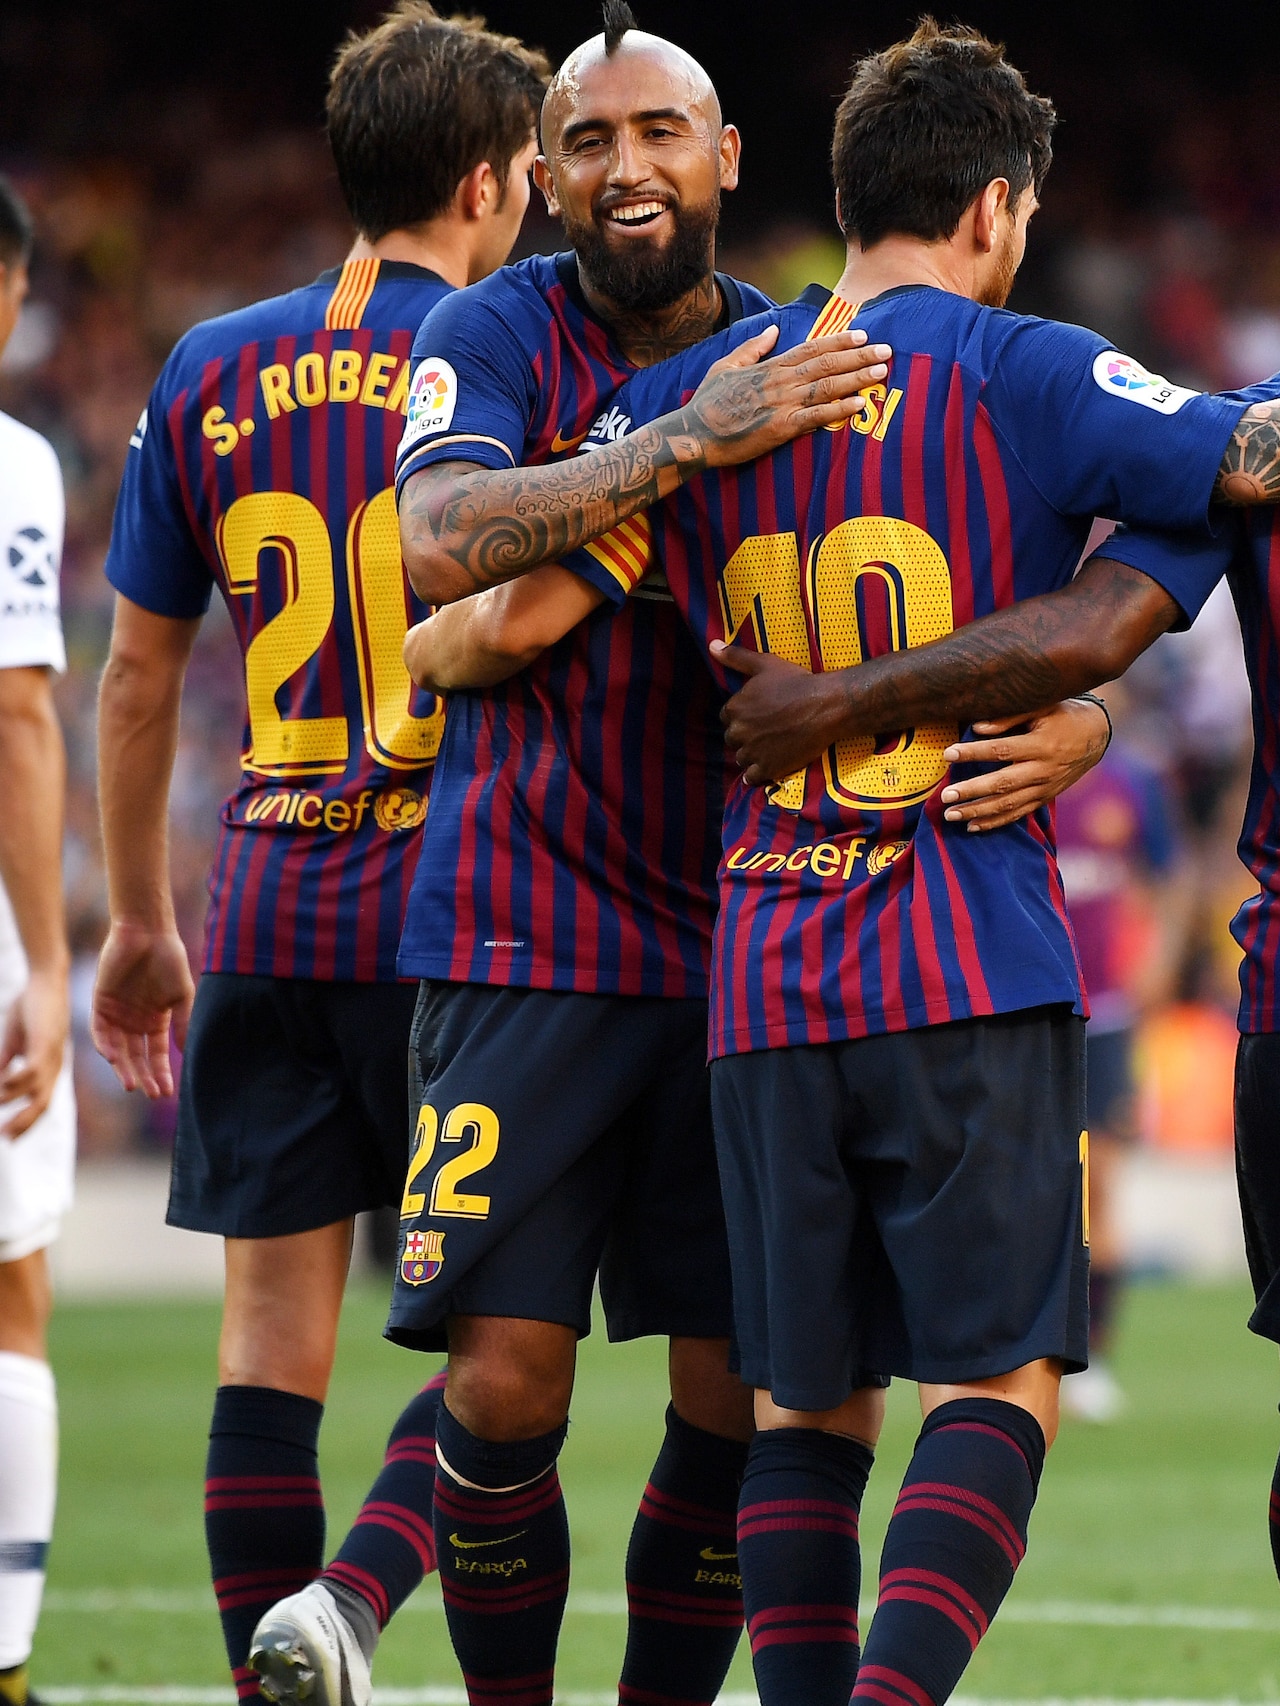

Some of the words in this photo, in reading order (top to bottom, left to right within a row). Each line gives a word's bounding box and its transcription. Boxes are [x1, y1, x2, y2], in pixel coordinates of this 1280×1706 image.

[202, 405, 256, 457] S.
[215, 486, 447, 777] 20
[717, 515, 958, 815] 10
[245, 789, 373, 832] unicef
[399, 1102, 500, 1220] 22
[455, 1556, 528, 1577] BARÇA
